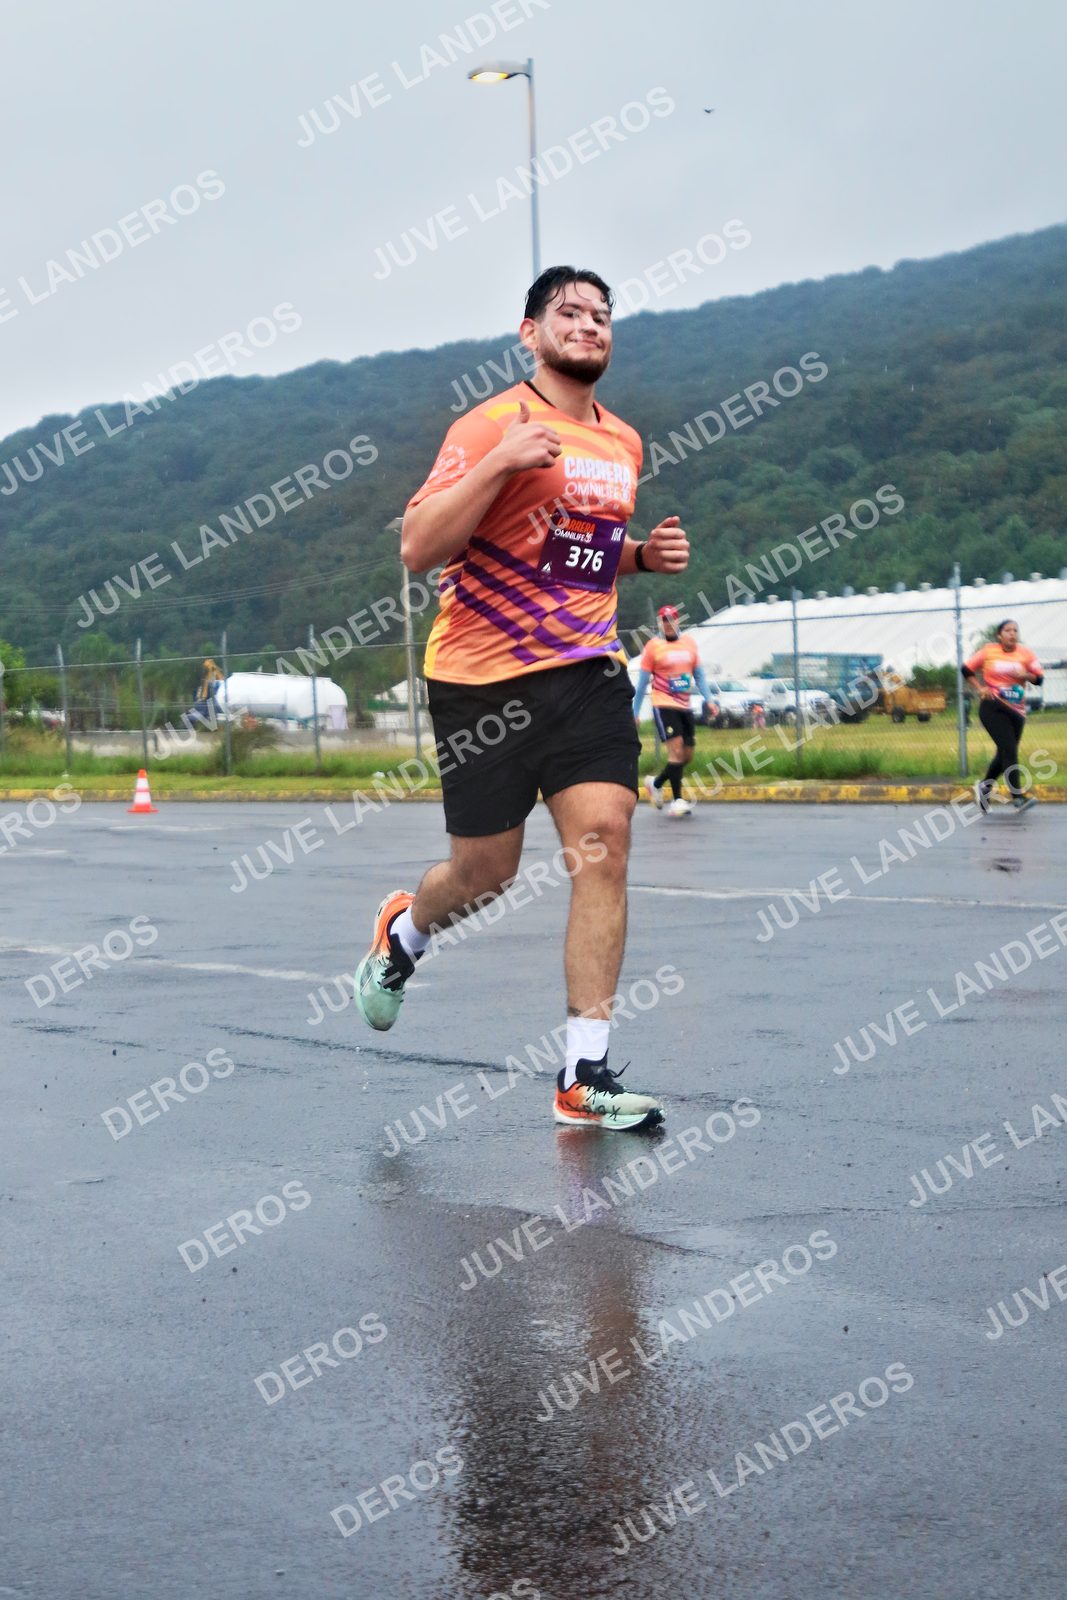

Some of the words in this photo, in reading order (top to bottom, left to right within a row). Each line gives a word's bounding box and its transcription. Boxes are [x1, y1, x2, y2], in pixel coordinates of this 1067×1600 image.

[564, 456, 630, 484] CARRERA
[554, 528, 585, 542] OMNILIFE
[557, 517, 596, 534] CARRERA
[565, 545, 604, 572] 376
